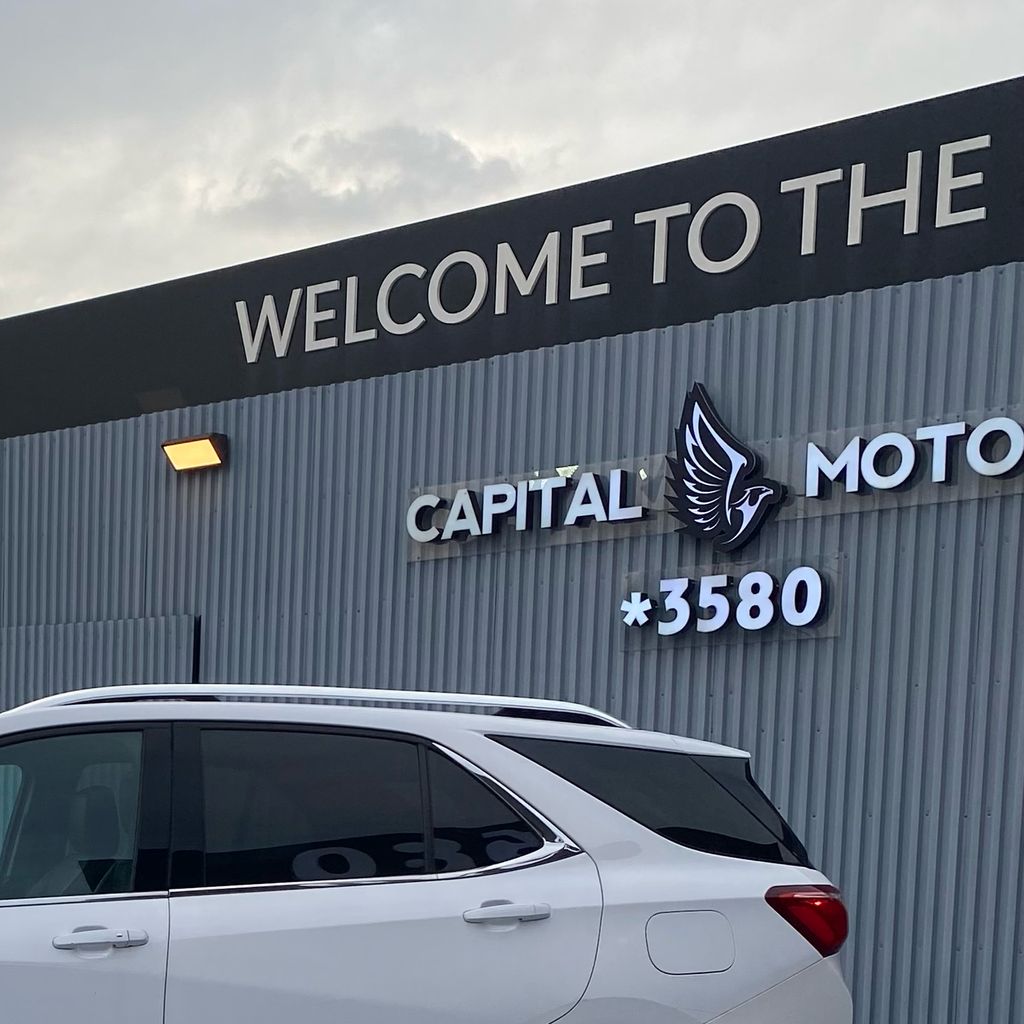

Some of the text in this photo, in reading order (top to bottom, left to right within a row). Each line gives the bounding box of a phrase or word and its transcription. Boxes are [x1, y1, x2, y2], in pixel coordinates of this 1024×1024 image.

[235, 134, 991, 363] WELCOME TO THE
[406, 416, 1024, 543] CAPITAL MOTO
